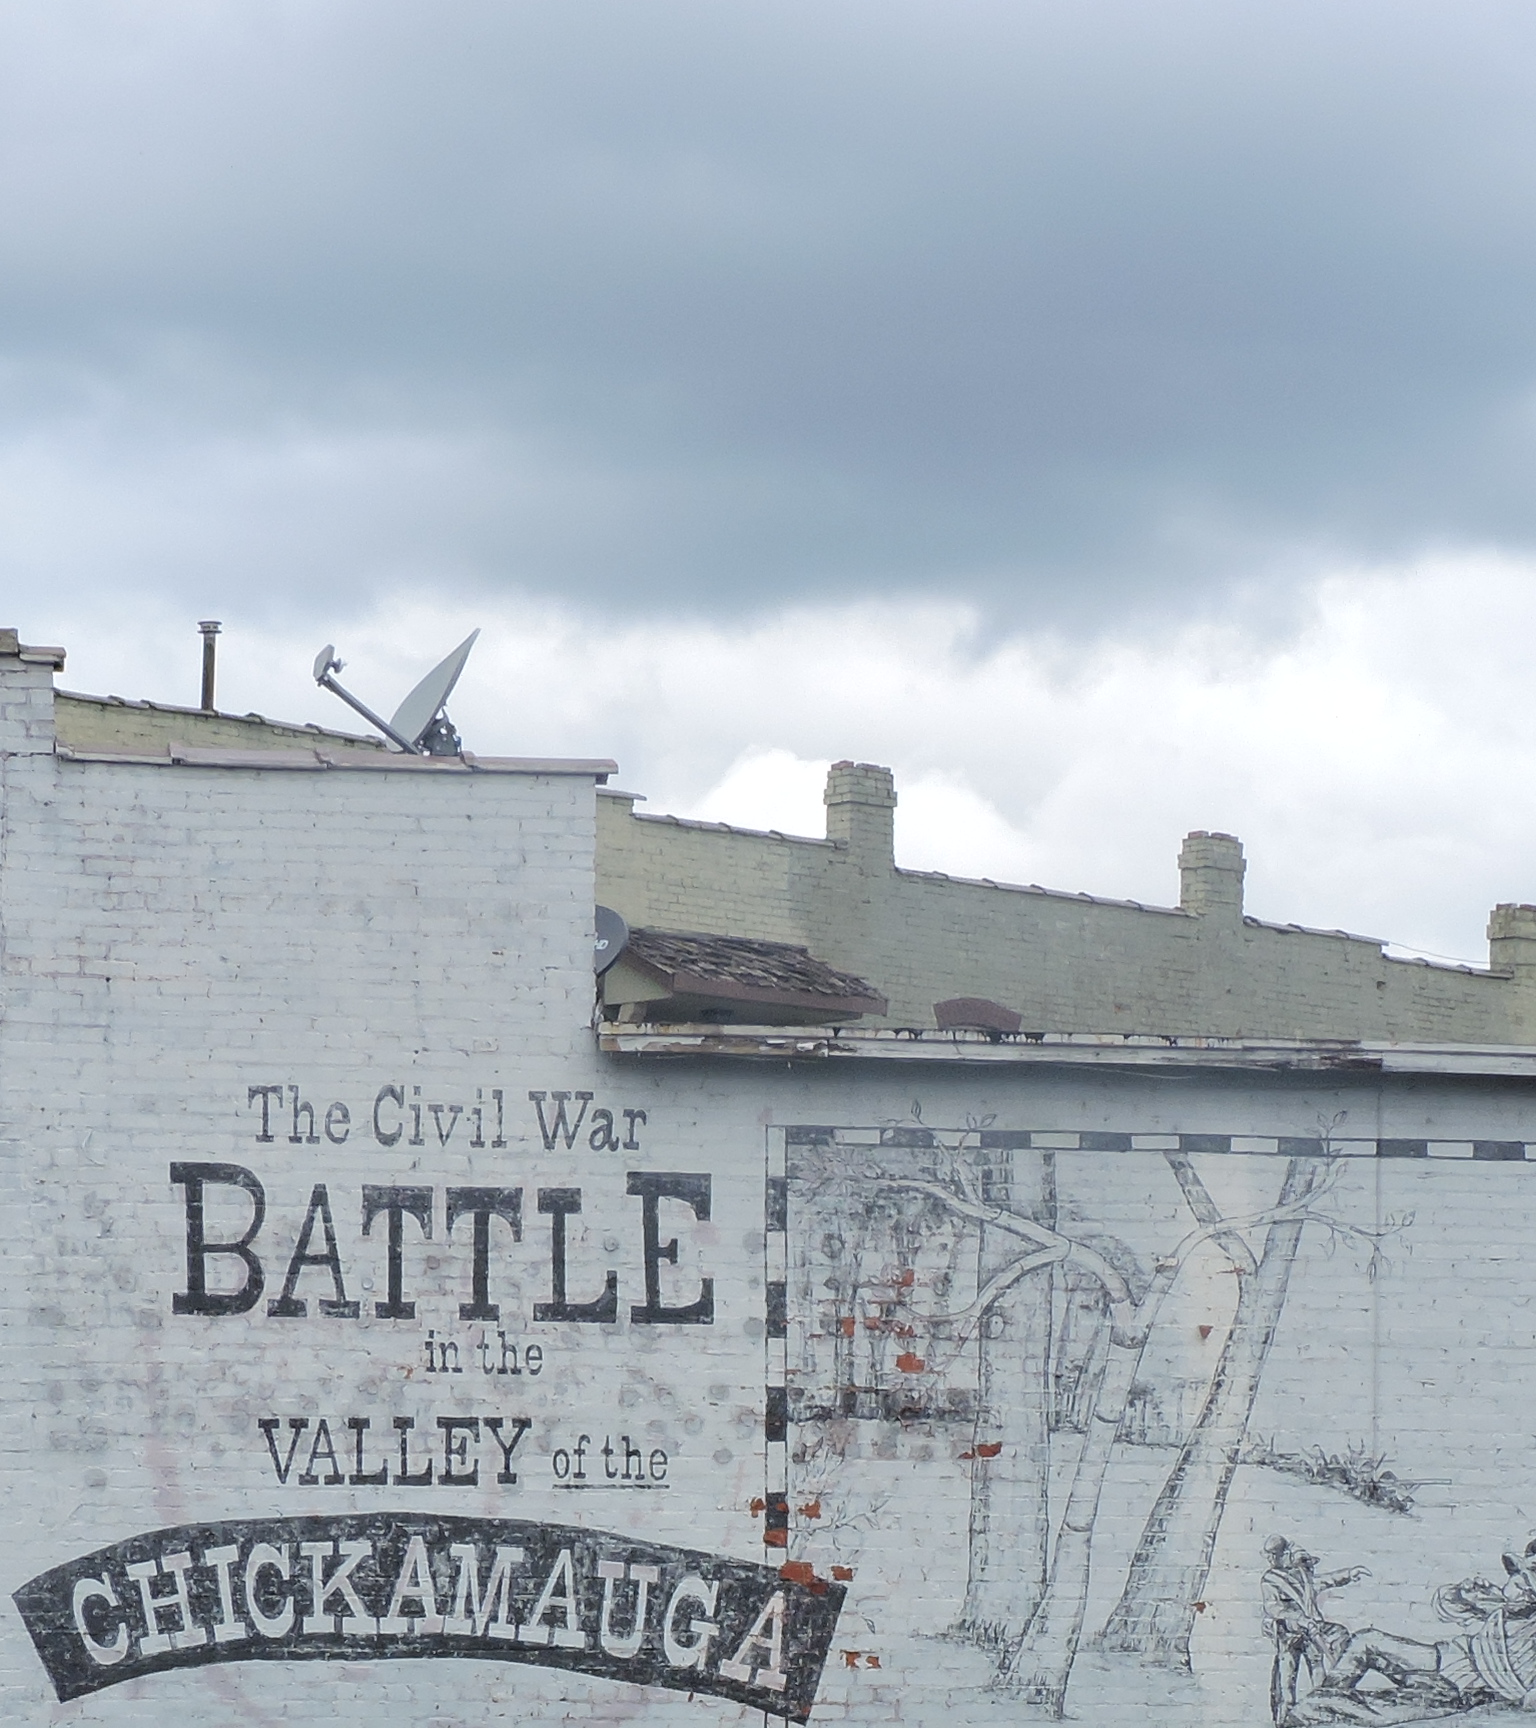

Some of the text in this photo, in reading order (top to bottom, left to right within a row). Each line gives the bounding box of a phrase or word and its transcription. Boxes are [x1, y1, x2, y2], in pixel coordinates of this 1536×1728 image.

[248, 1085, 648, 1152] The Civil War
[170, 1161, 715, 1325] BATTLE
[425, 1330, 544, 1376] in the
[258, 1416, 670, 1487] VALLEY of the
[71, 1535, 790, 1688] CHICKAMAUGA
